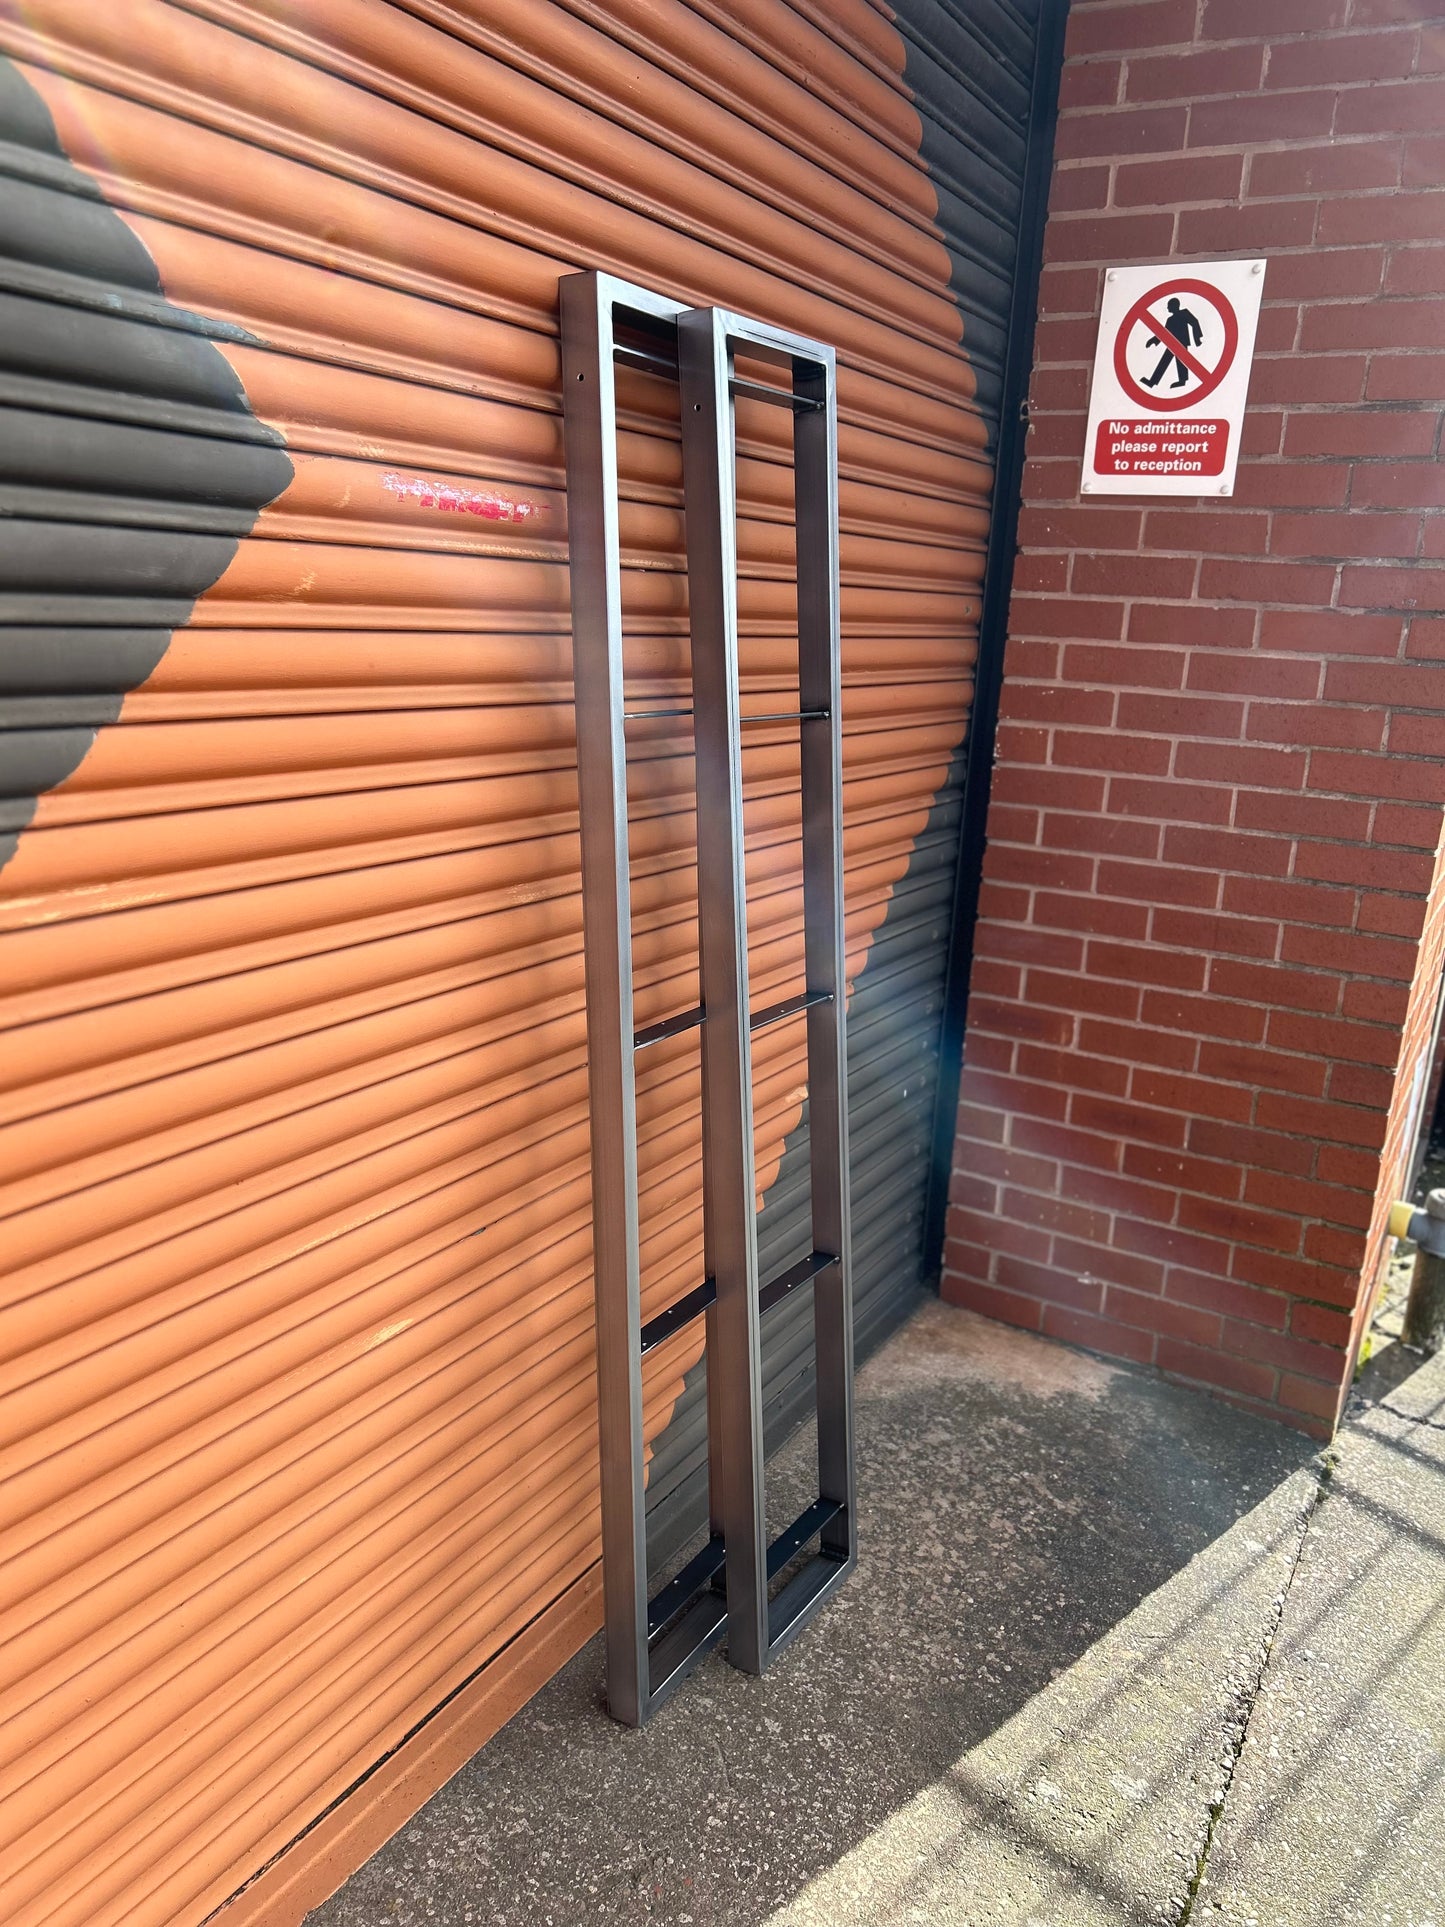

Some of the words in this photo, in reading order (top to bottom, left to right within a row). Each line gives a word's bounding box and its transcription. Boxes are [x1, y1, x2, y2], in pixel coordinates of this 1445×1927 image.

[1109, 422, 1129, 434] No
[1134, 422, 1216, 434] admittance
[1111, 440, 1157, 455] please
[1162, 441, 1208, 455] report
[1115, 459, 1129, 470] to
[1134, 458, 1201, 473] reception
